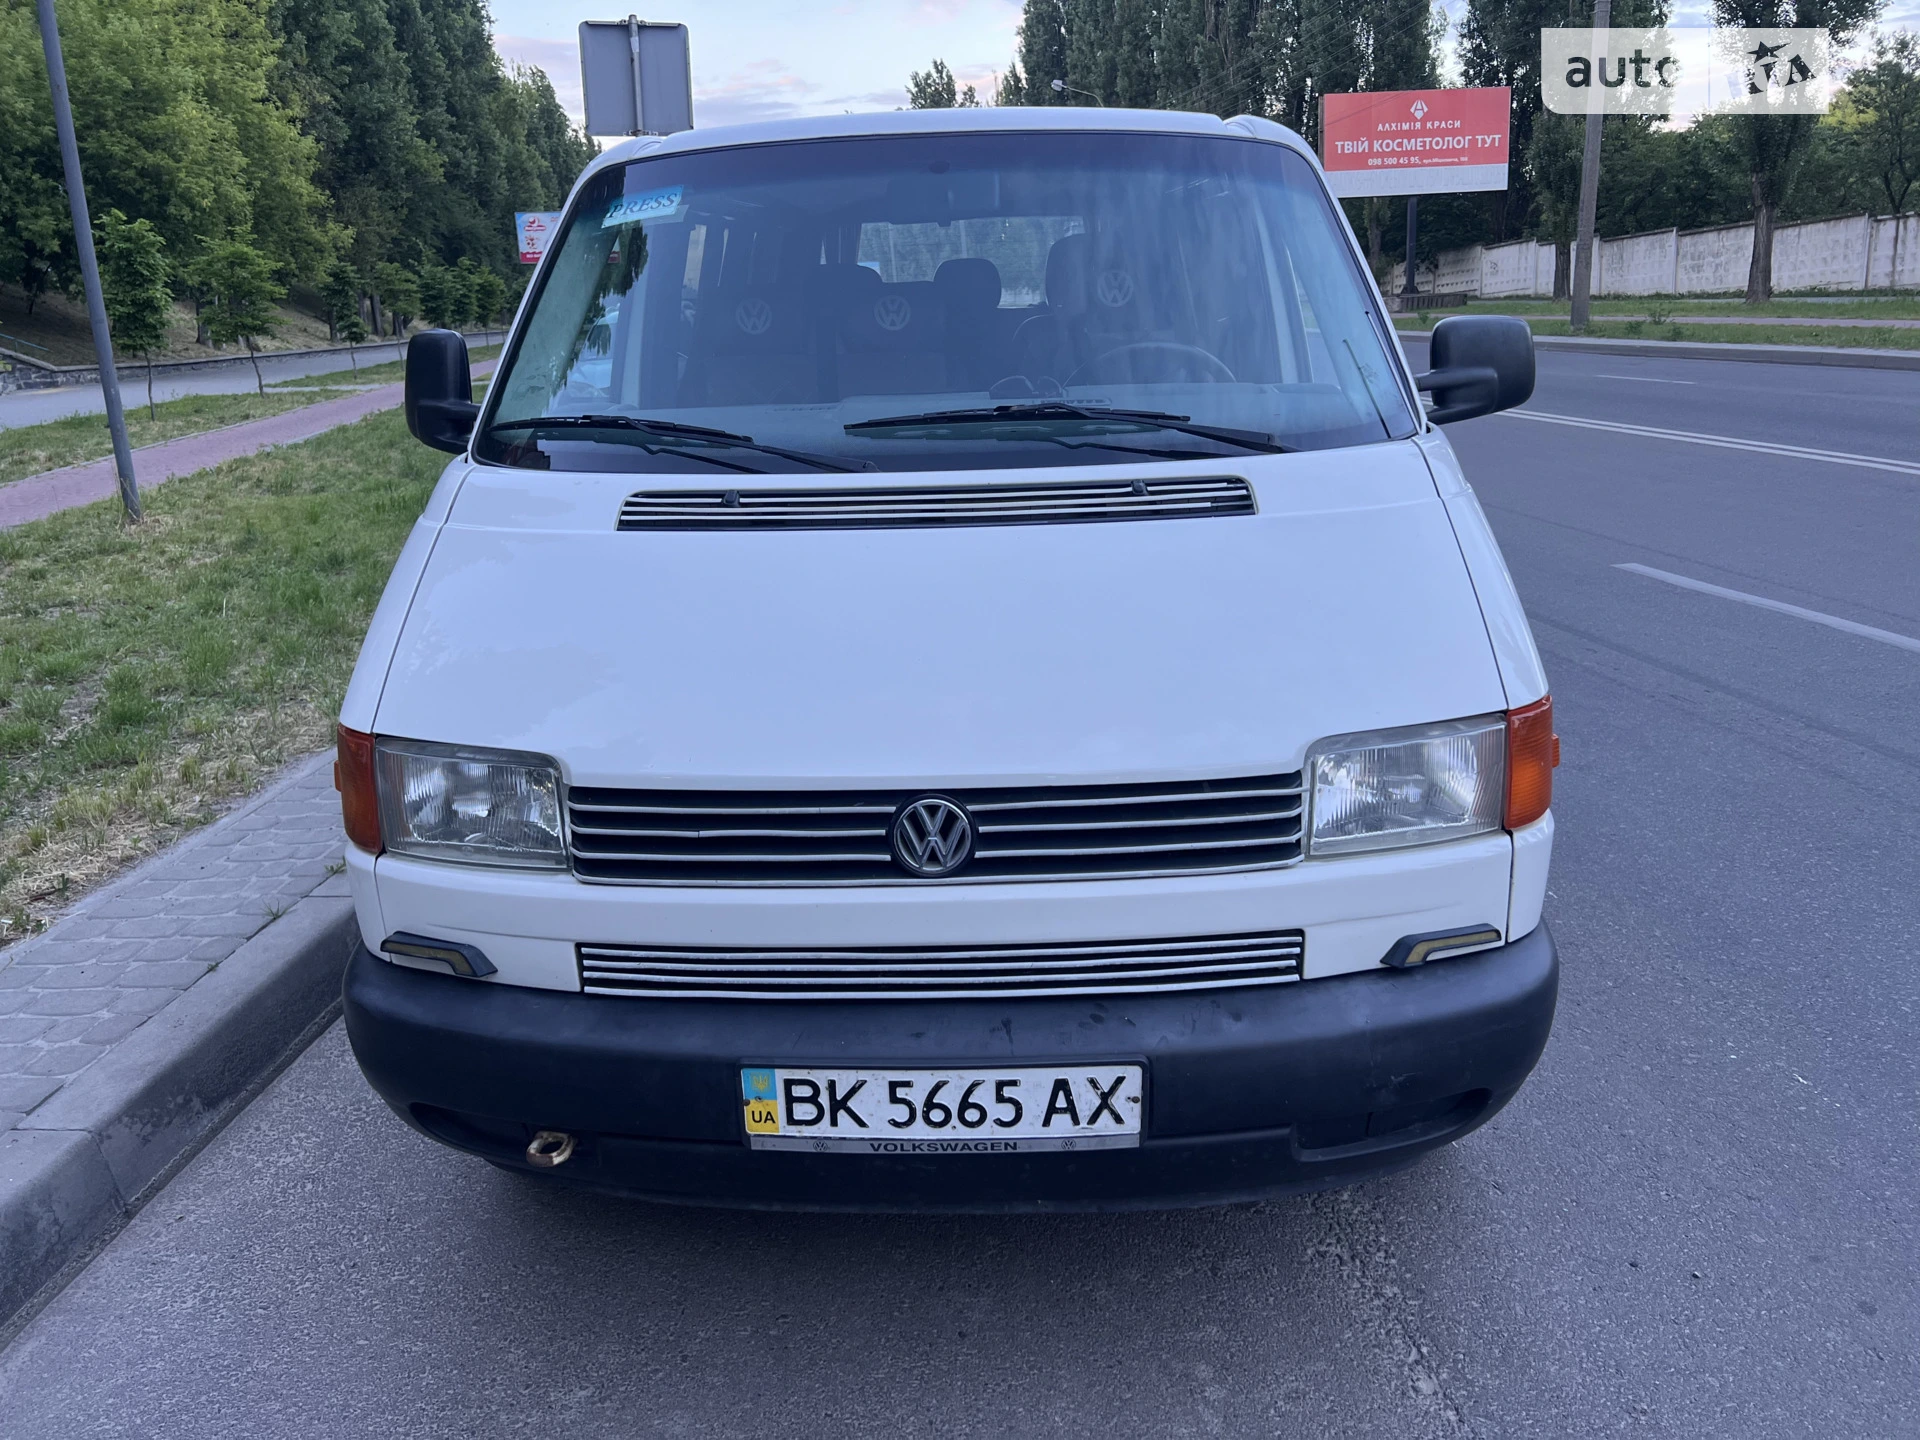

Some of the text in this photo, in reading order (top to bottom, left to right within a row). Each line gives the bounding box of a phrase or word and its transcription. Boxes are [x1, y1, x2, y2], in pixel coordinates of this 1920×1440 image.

[1377, 120, 1461, 131] АЛХІМІЯ КРАСИ
[1335, 134, 1502, 154] ТВІЙ КОСМЕТОЛОГ ТУТ
[1368, 158, 1382, 166] 098
[1383, 157, 1398, 165] 500
[1399, 156, 1409, 164] 45
[607, 193, 677, 218] PRESS
[893, 799, 972, 873] VW
[783, 1075, 1126, 1128] BK 5665 AX
[751, 1110, 776, 1124] UA
[869, 1141, 1018, 1152] VOLKSWAGEN
